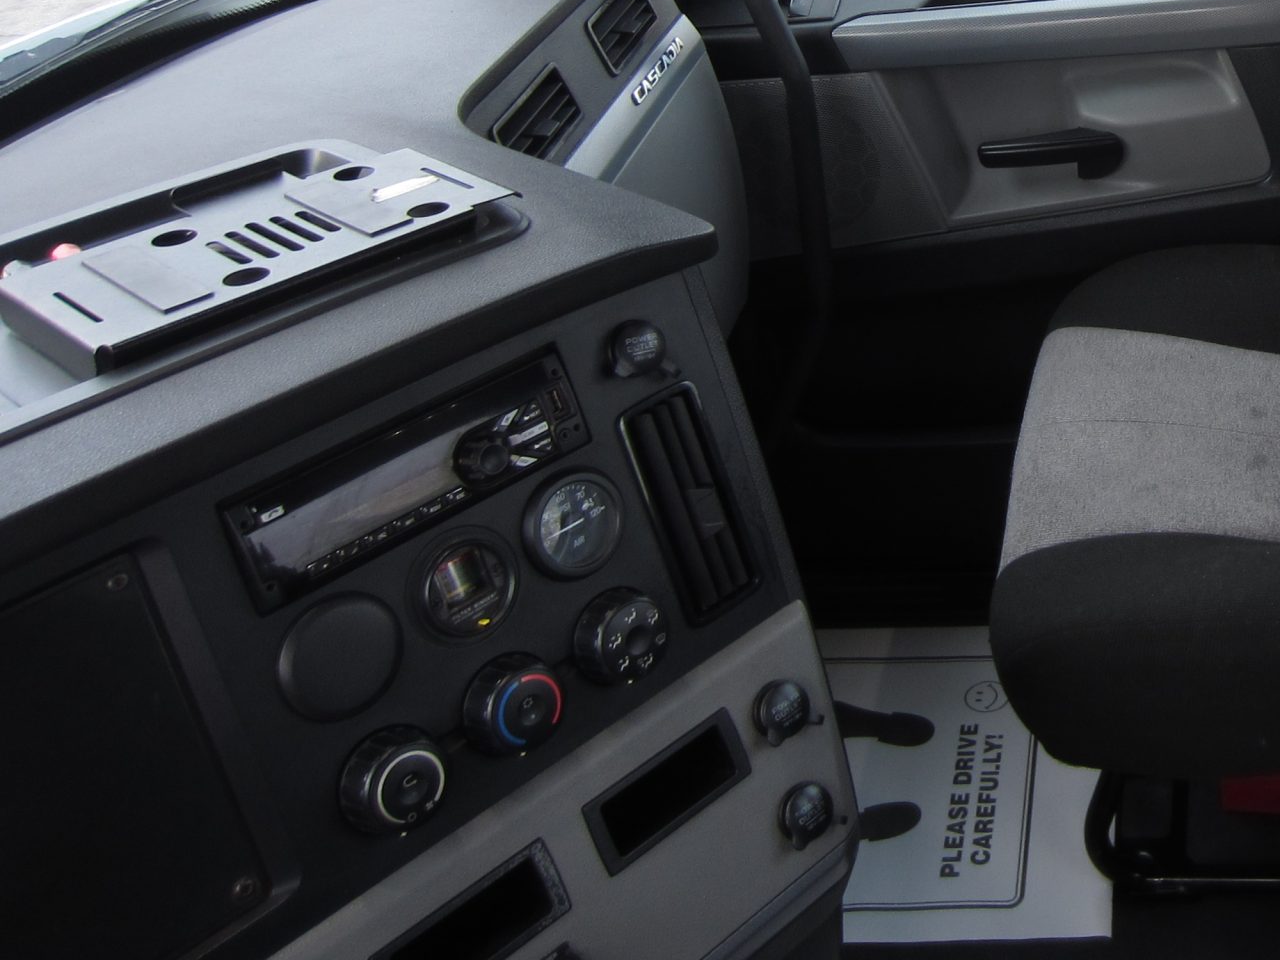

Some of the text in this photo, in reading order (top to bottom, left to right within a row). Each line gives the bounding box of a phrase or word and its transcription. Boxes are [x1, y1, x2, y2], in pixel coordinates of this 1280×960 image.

[632, 37, 684, 106] CASCADIA
[940, 723, 979, 878] PLEASE DRIVE
[970, 734, 1004, 865] CAREFULLY!
